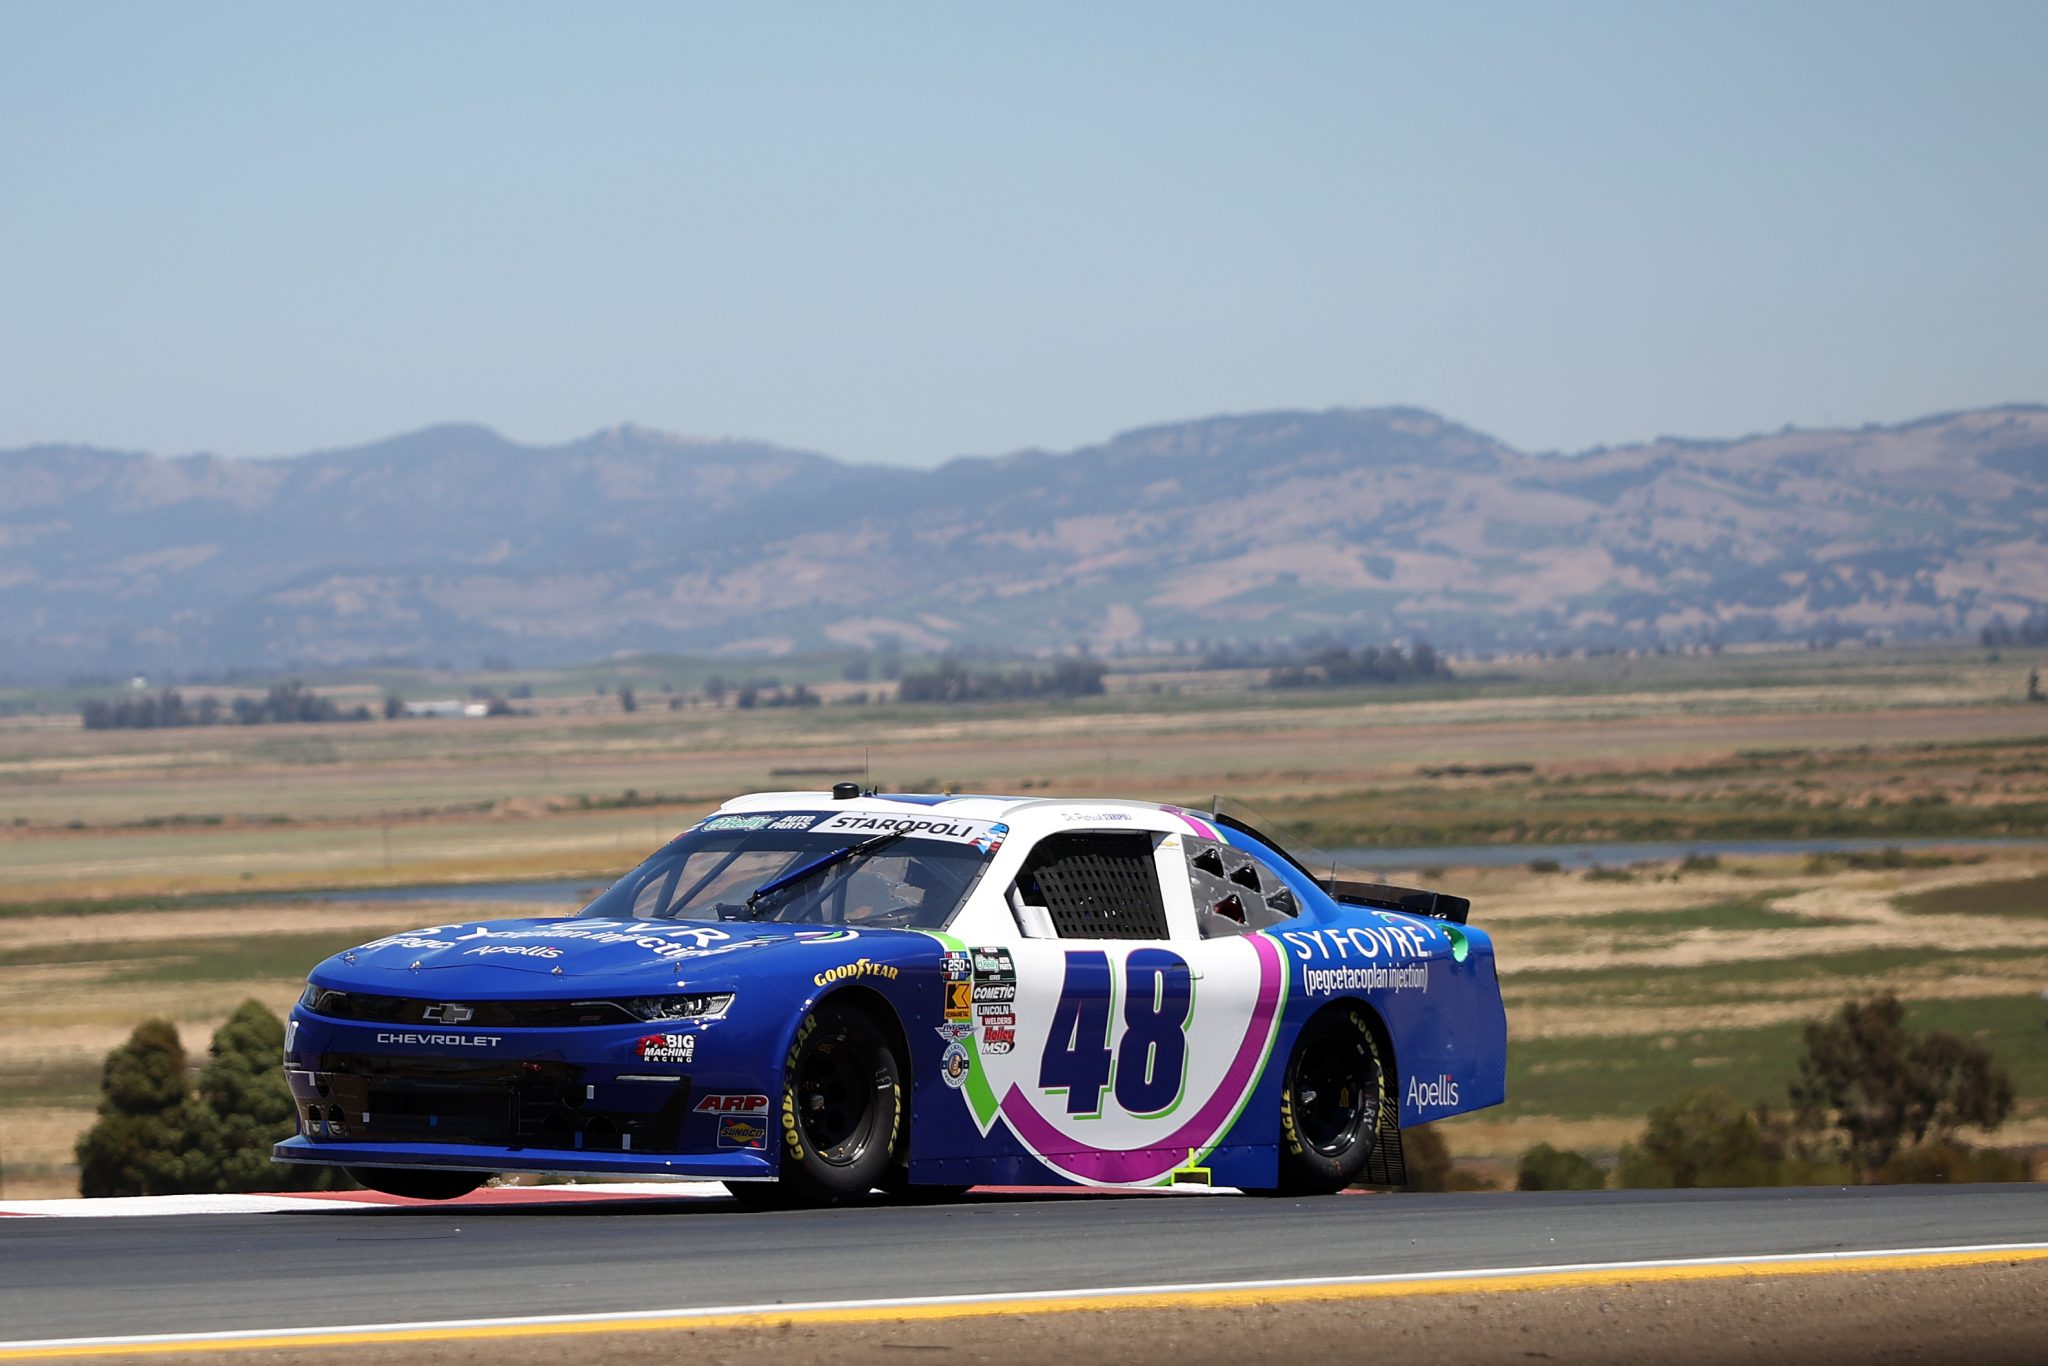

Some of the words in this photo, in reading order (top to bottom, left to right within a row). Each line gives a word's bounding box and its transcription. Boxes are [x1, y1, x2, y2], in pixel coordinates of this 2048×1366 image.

[767, 821, 811, 830] PARTS
[779, 815, 816, 823] AUTO
[832, 817, 973, 838] STAROPOLI
[1282, 926, 1428, 960] SYFOVRE
[463, 945, 564, 958] Apellis
[948, 960, 965, 971] 250
[814, 959, 899, 987] GOODYEAR
[1303, 962, 1388, 996] (pegcetacoplan
[1389, 962, 1429, 994] injection)
[973, 986, 1015, 999] COMETIC
[978, 1006, 1009, 1015] LINCOLN
[984, 1017, 1012, 1025] WELDERS
[377, 1033, 502, 1047] CHEVROLET
[1039, 948, 1195, 1119] 48
[666, 1034, 695, 1048] BIG
[644, 1048, 693, 1057] MACHINE
[982, 1042, 1012, 1055] MSD
[1406, 1074, 1459, 1114] Apellis
[697, 1096, 768, 1112] ARP
[888, 1082, 901, 1158] EAGLE
[1281, 1089, 1303, 1155] EAGLE
[721, 1127, 765, 1138] SUNOCO
